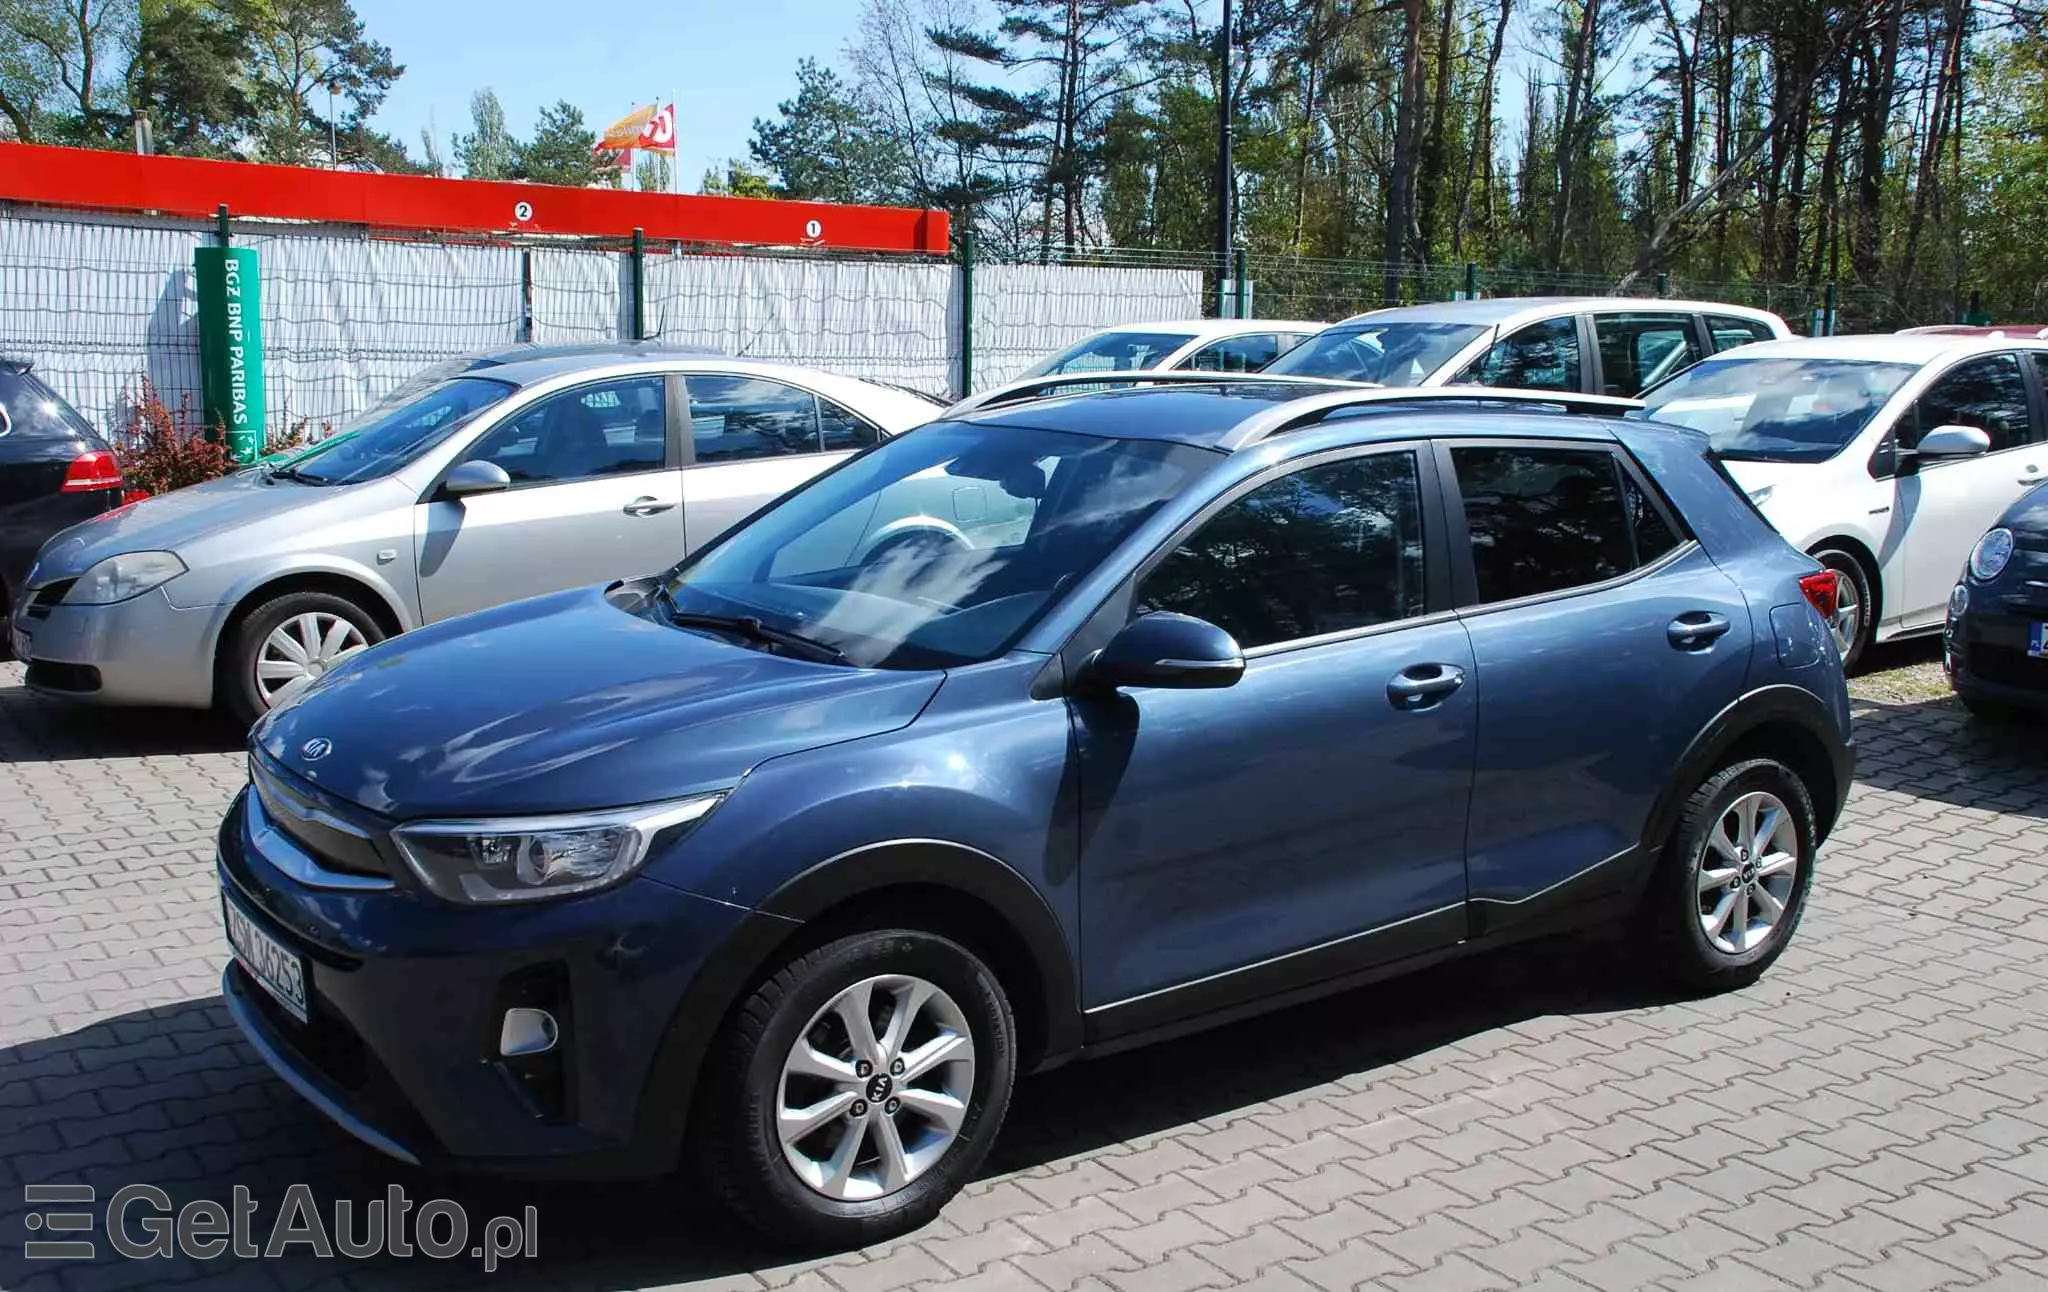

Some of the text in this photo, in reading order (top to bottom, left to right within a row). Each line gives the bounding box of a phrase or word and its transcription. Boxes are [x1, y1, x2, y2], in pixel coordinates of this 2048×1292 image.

[519, 204, 528, 218] 2
[227, 303, 243, 342] BNP
[229, 346, 248, 425] PARIBAS
[871, 1077, 888, 1101] KIA
